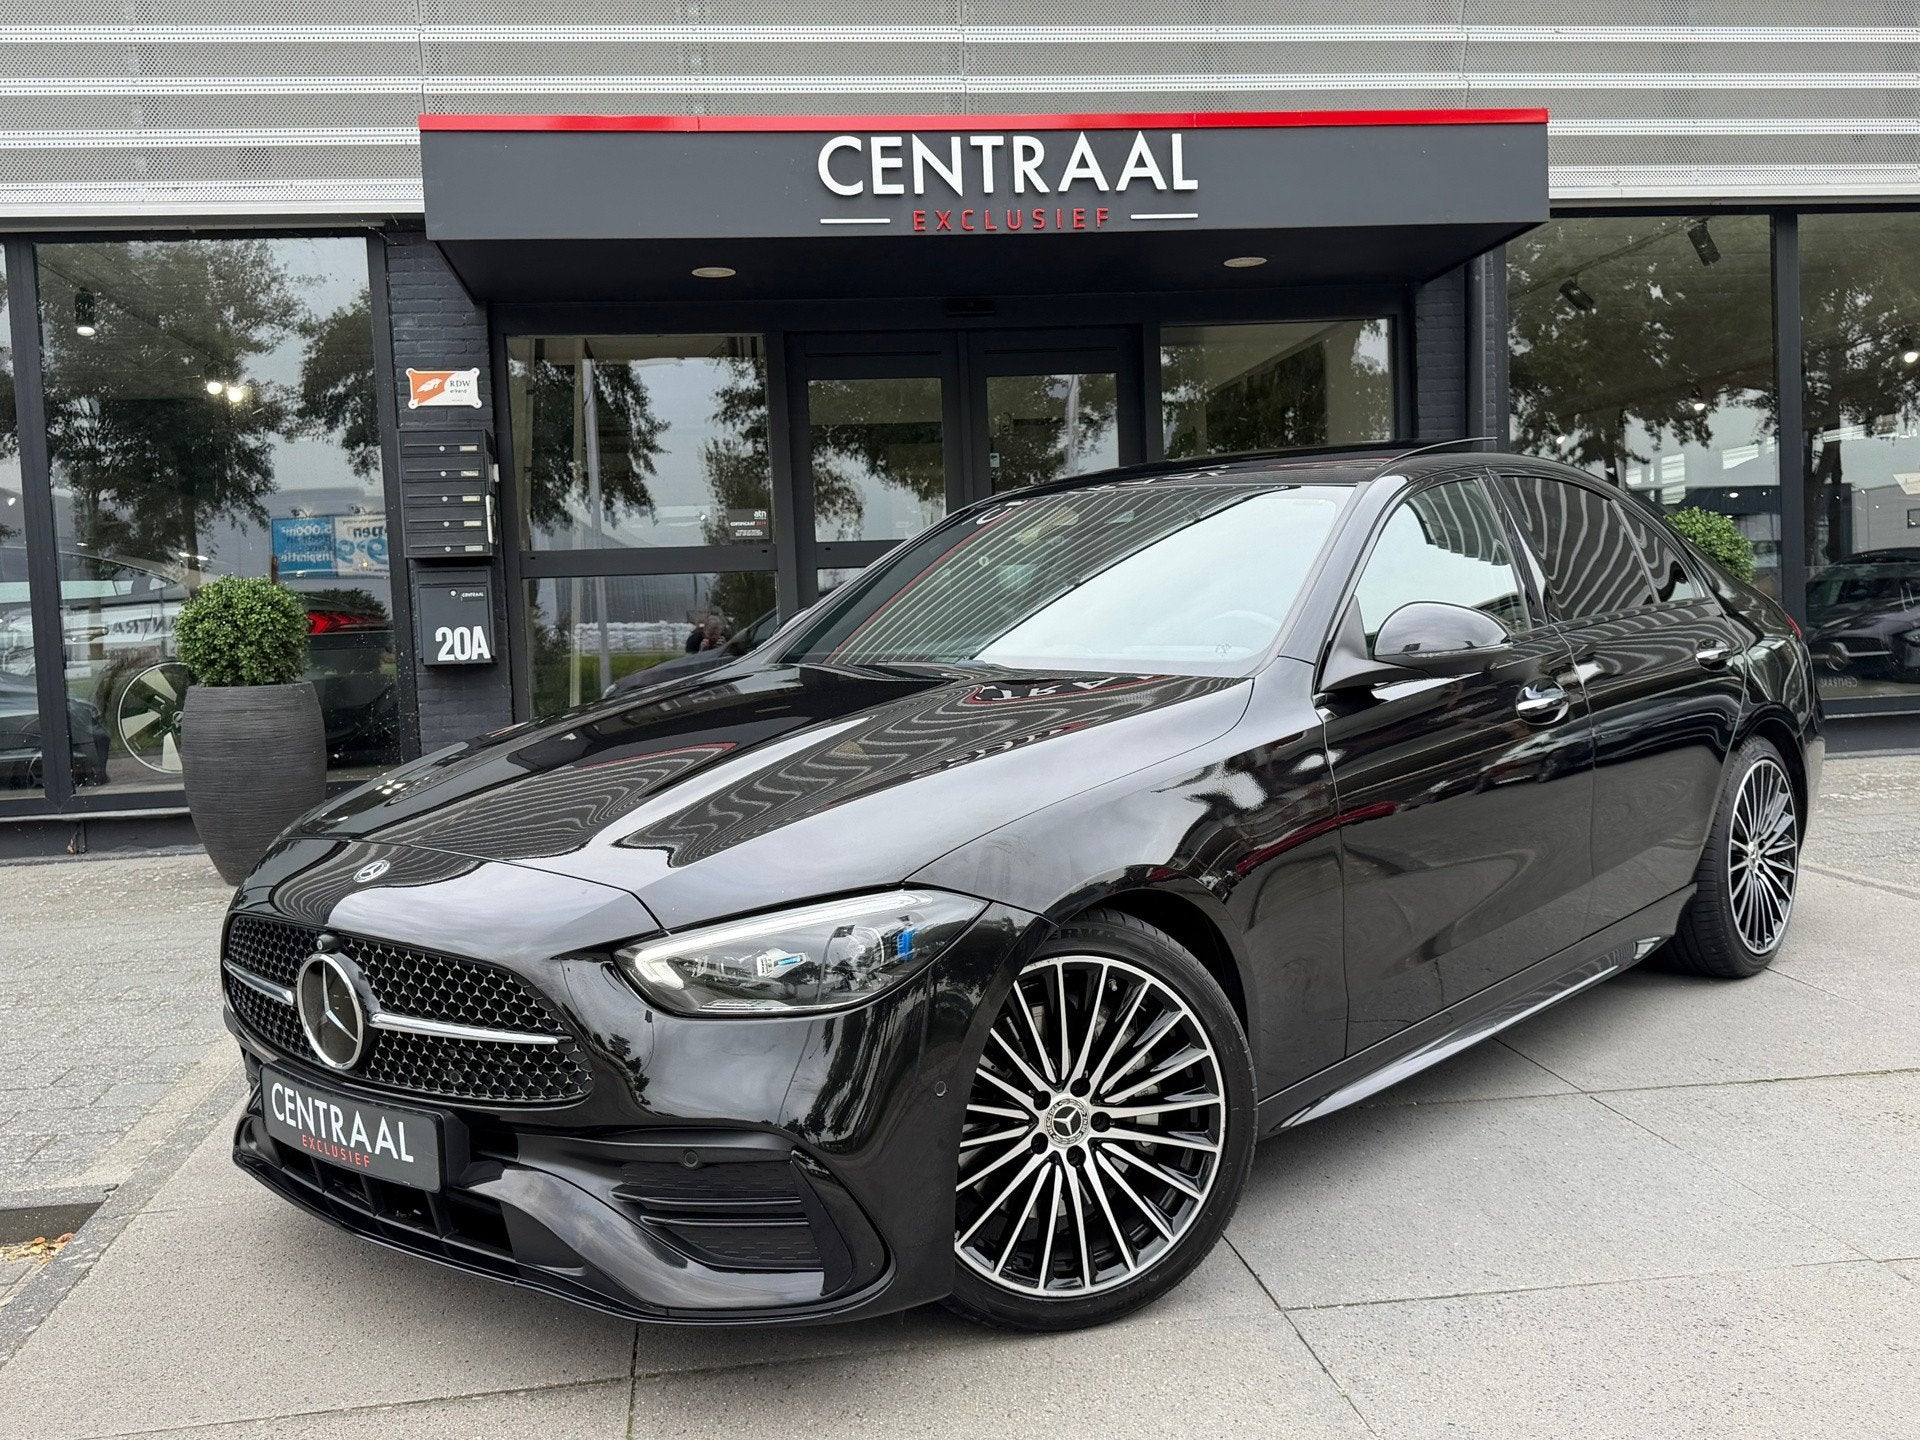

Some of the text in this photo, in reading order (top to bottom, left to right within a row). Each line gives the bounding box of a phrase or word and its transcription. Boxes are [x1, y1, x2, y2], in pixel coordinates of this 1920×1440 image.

[817, 131, 1199, 197] CENTRAAL
[912, 207, 1110, 231] EXCLUSIEF
[435, 626, 490, 661] 20A
[271, 1082, 414, 1163] CENTRAAL
[302, 1134, 370, 1168] EXCLUSIEF
